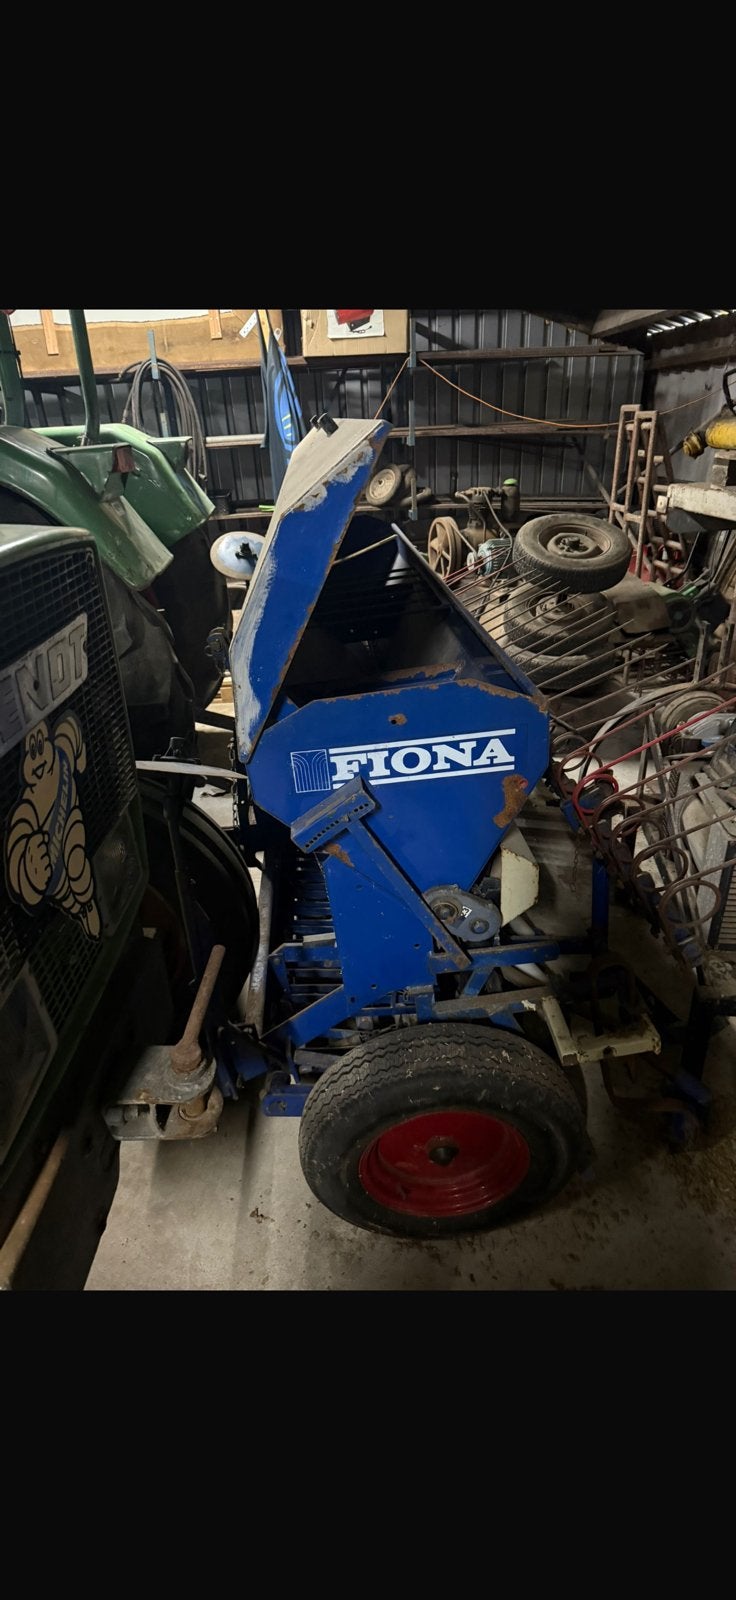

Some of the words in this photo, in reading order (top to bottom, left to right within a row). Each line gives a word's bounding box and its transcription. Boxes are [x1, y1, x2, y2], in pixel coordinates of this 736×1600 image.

[0, 622, 85, 743] ENDT
[49, 759, 69, 869] MICHELIN
[330, 738, 515, 781] FIONA
